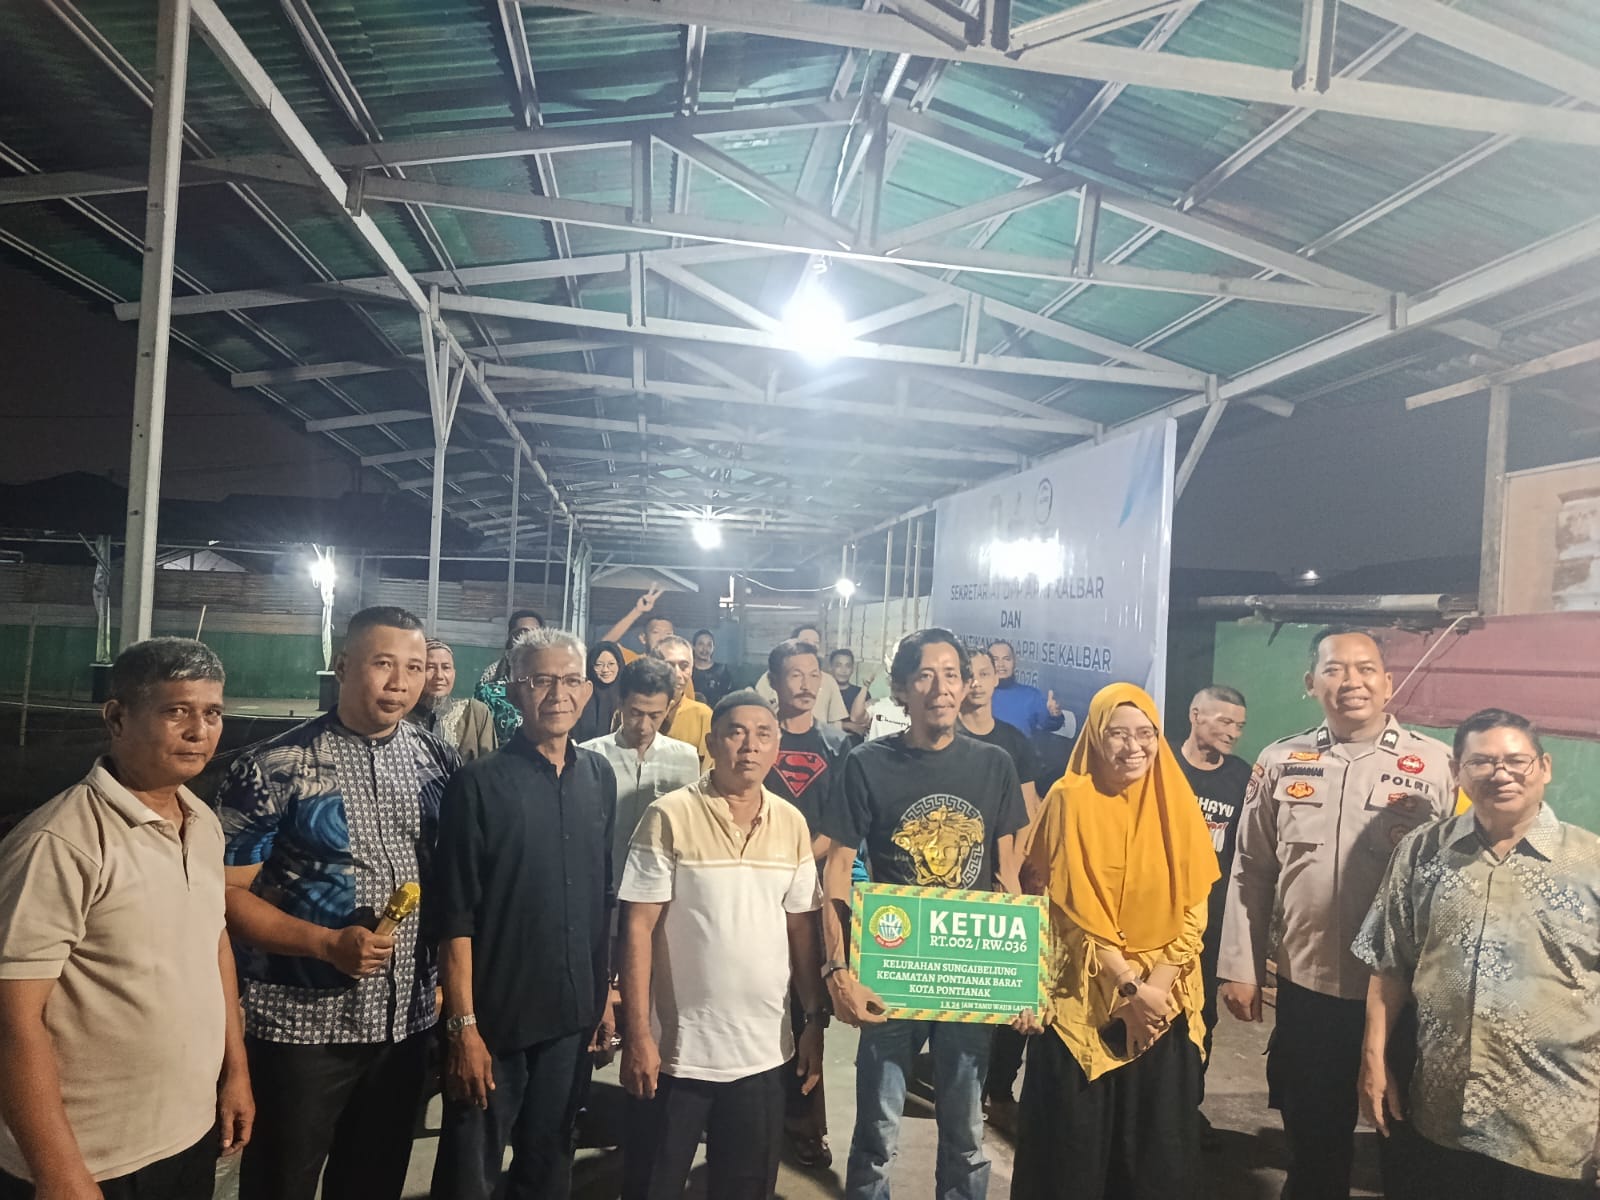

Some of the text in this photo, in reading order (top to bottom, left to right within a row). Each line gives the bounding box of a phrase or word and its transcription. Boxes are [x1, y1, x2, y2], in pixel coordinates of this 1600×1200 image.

[1055, 576, 1104, 599] KALBAR
[1000, 610, 1021, 629] DAN
[1016, 641, 1039, 660] APRI
[1041, 642, 1055, 663] SE
[1058, 645, 1112, 671] KALBAR
[1380, 773, 1430, 795] POLRI
[1197, 797, 1235, 818] HAYU
[929, 910, 1027, 940] KETUA
[929, 936, 974, 949] RT.002
[982, 939, 1028, 953] RW.036
[883, 959, 1017, 976] KELURAHAN SUNGAIBELIUNG
[876, 970, 1023, 988] KECAMATAN PONTIANAK BARAT
[909, 984, 991, 998] KOTA PONTIANAK
